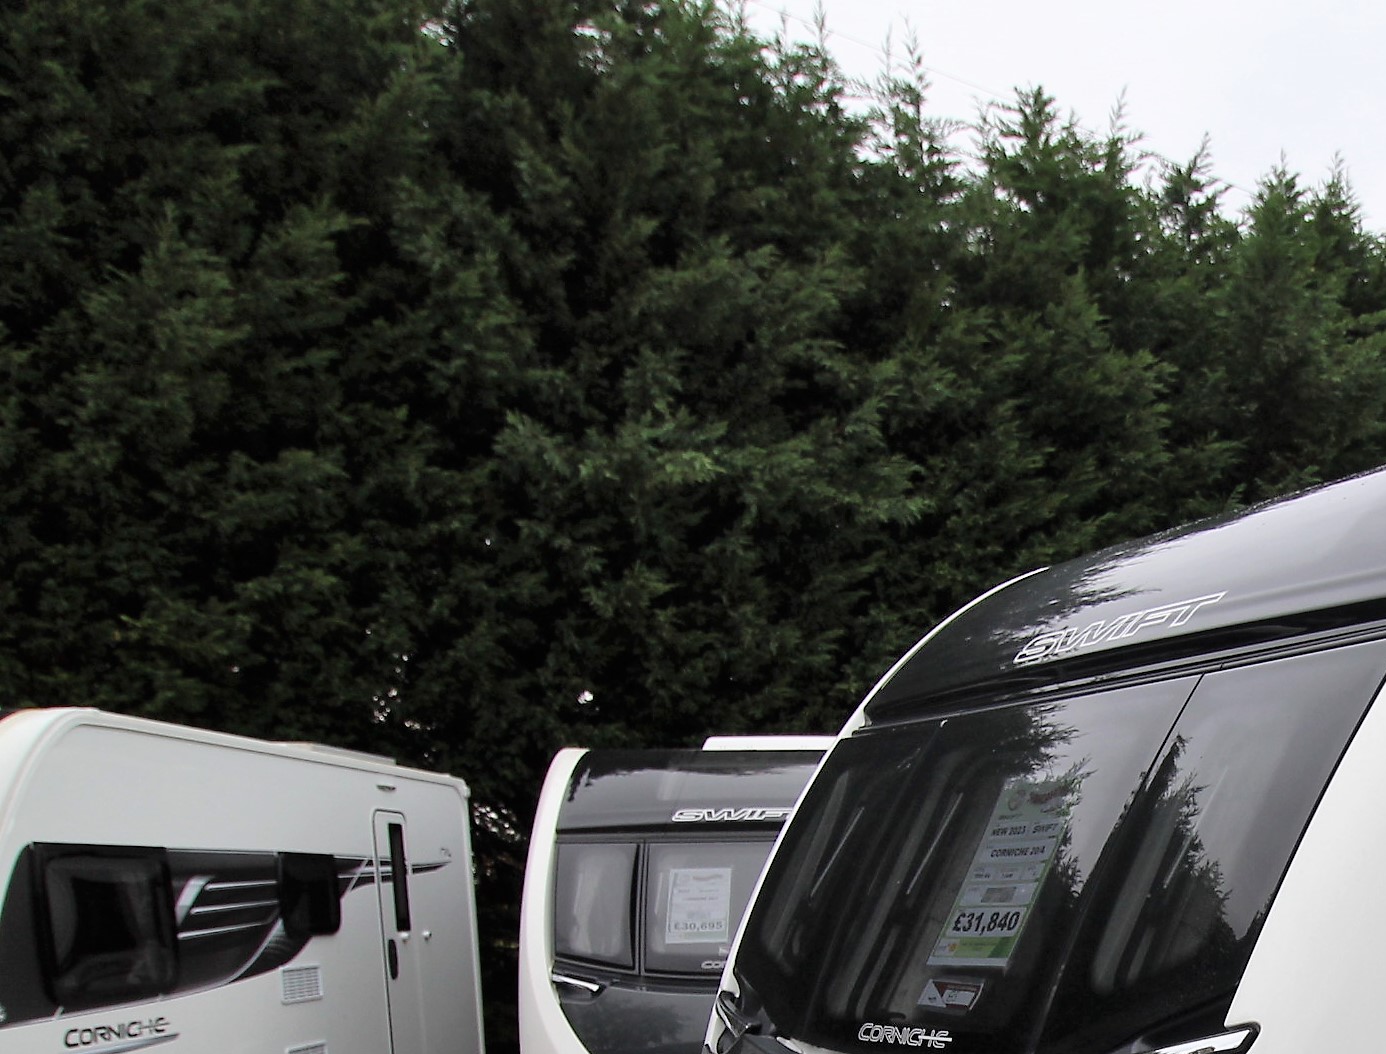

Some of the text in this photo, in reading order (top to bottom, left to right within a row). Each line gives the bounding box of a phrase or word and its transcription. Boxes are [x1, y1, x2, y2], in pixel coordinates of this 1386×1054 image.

[1013, 591, 1228, 664] SWIFT
[952, 911, 1020, 936] £31,840
[64, 1017, 171, 1048] CORNICHE
[858, 1022, 953, 1049] CORNICHE
